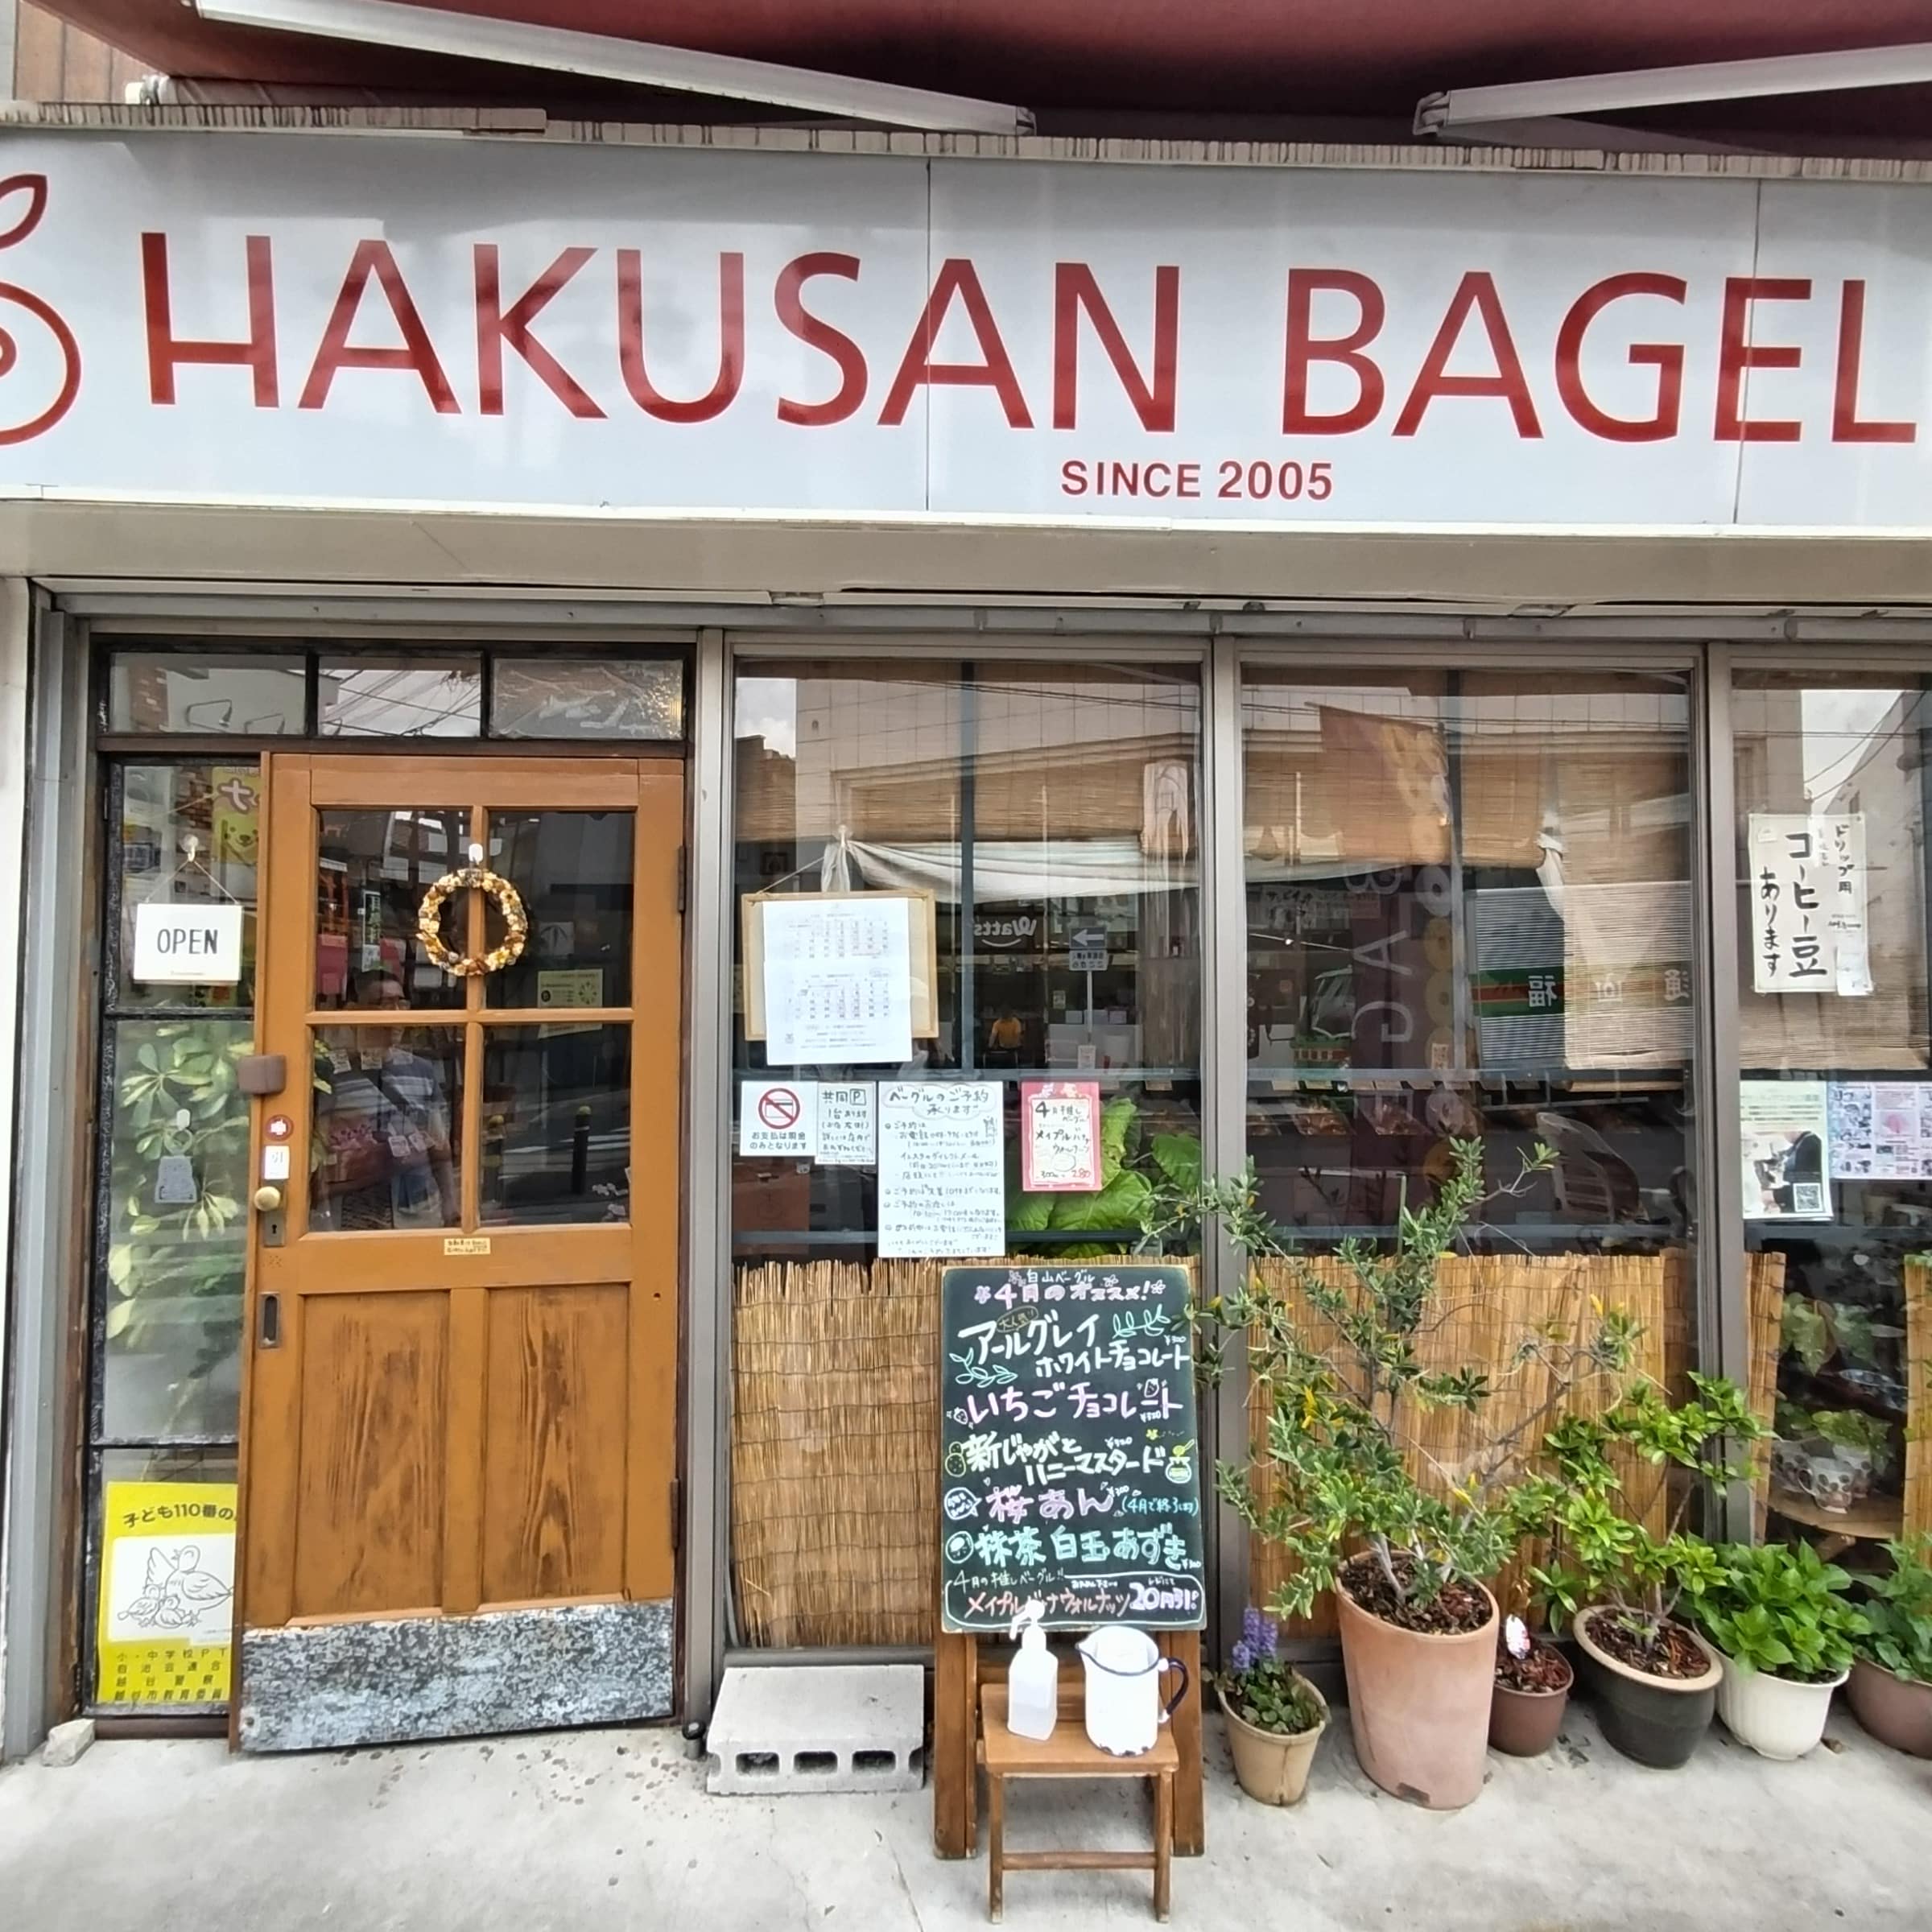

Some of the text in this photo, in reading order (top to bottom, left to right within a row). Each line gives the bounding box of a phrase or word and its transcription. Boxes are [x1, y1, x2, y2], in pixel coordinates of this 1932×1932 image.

[140, 232, 1918, 444] HAKUSAN BAGEL
[1060, 460, 1334, 499] SINCE 2005
[1760, 865, 1781, 977] あります
[1785, 832, 1827, 977] コーヒー豆
[156, 928, 219, 956] OPEN
[889, 1086, 989, 1104] ベーグルのご予約
[749, 1141, 807, 1150] のみとなります
[751, 1132, 807, 1141] お支払は現金
[1026, 1269, 1095, 1283] 白山ベーグル
[957, 1309, 1100, 1365] アールグレイ
[1035, 1339, 1191, 1377] ホワイトチョコレート
[967, 1381, 1183, 1424] いちごチョコレート
[1025, 1445, 1166, 1486] ハニーマスタード
[123, 1503, 237, 1528] 子ども110番の
